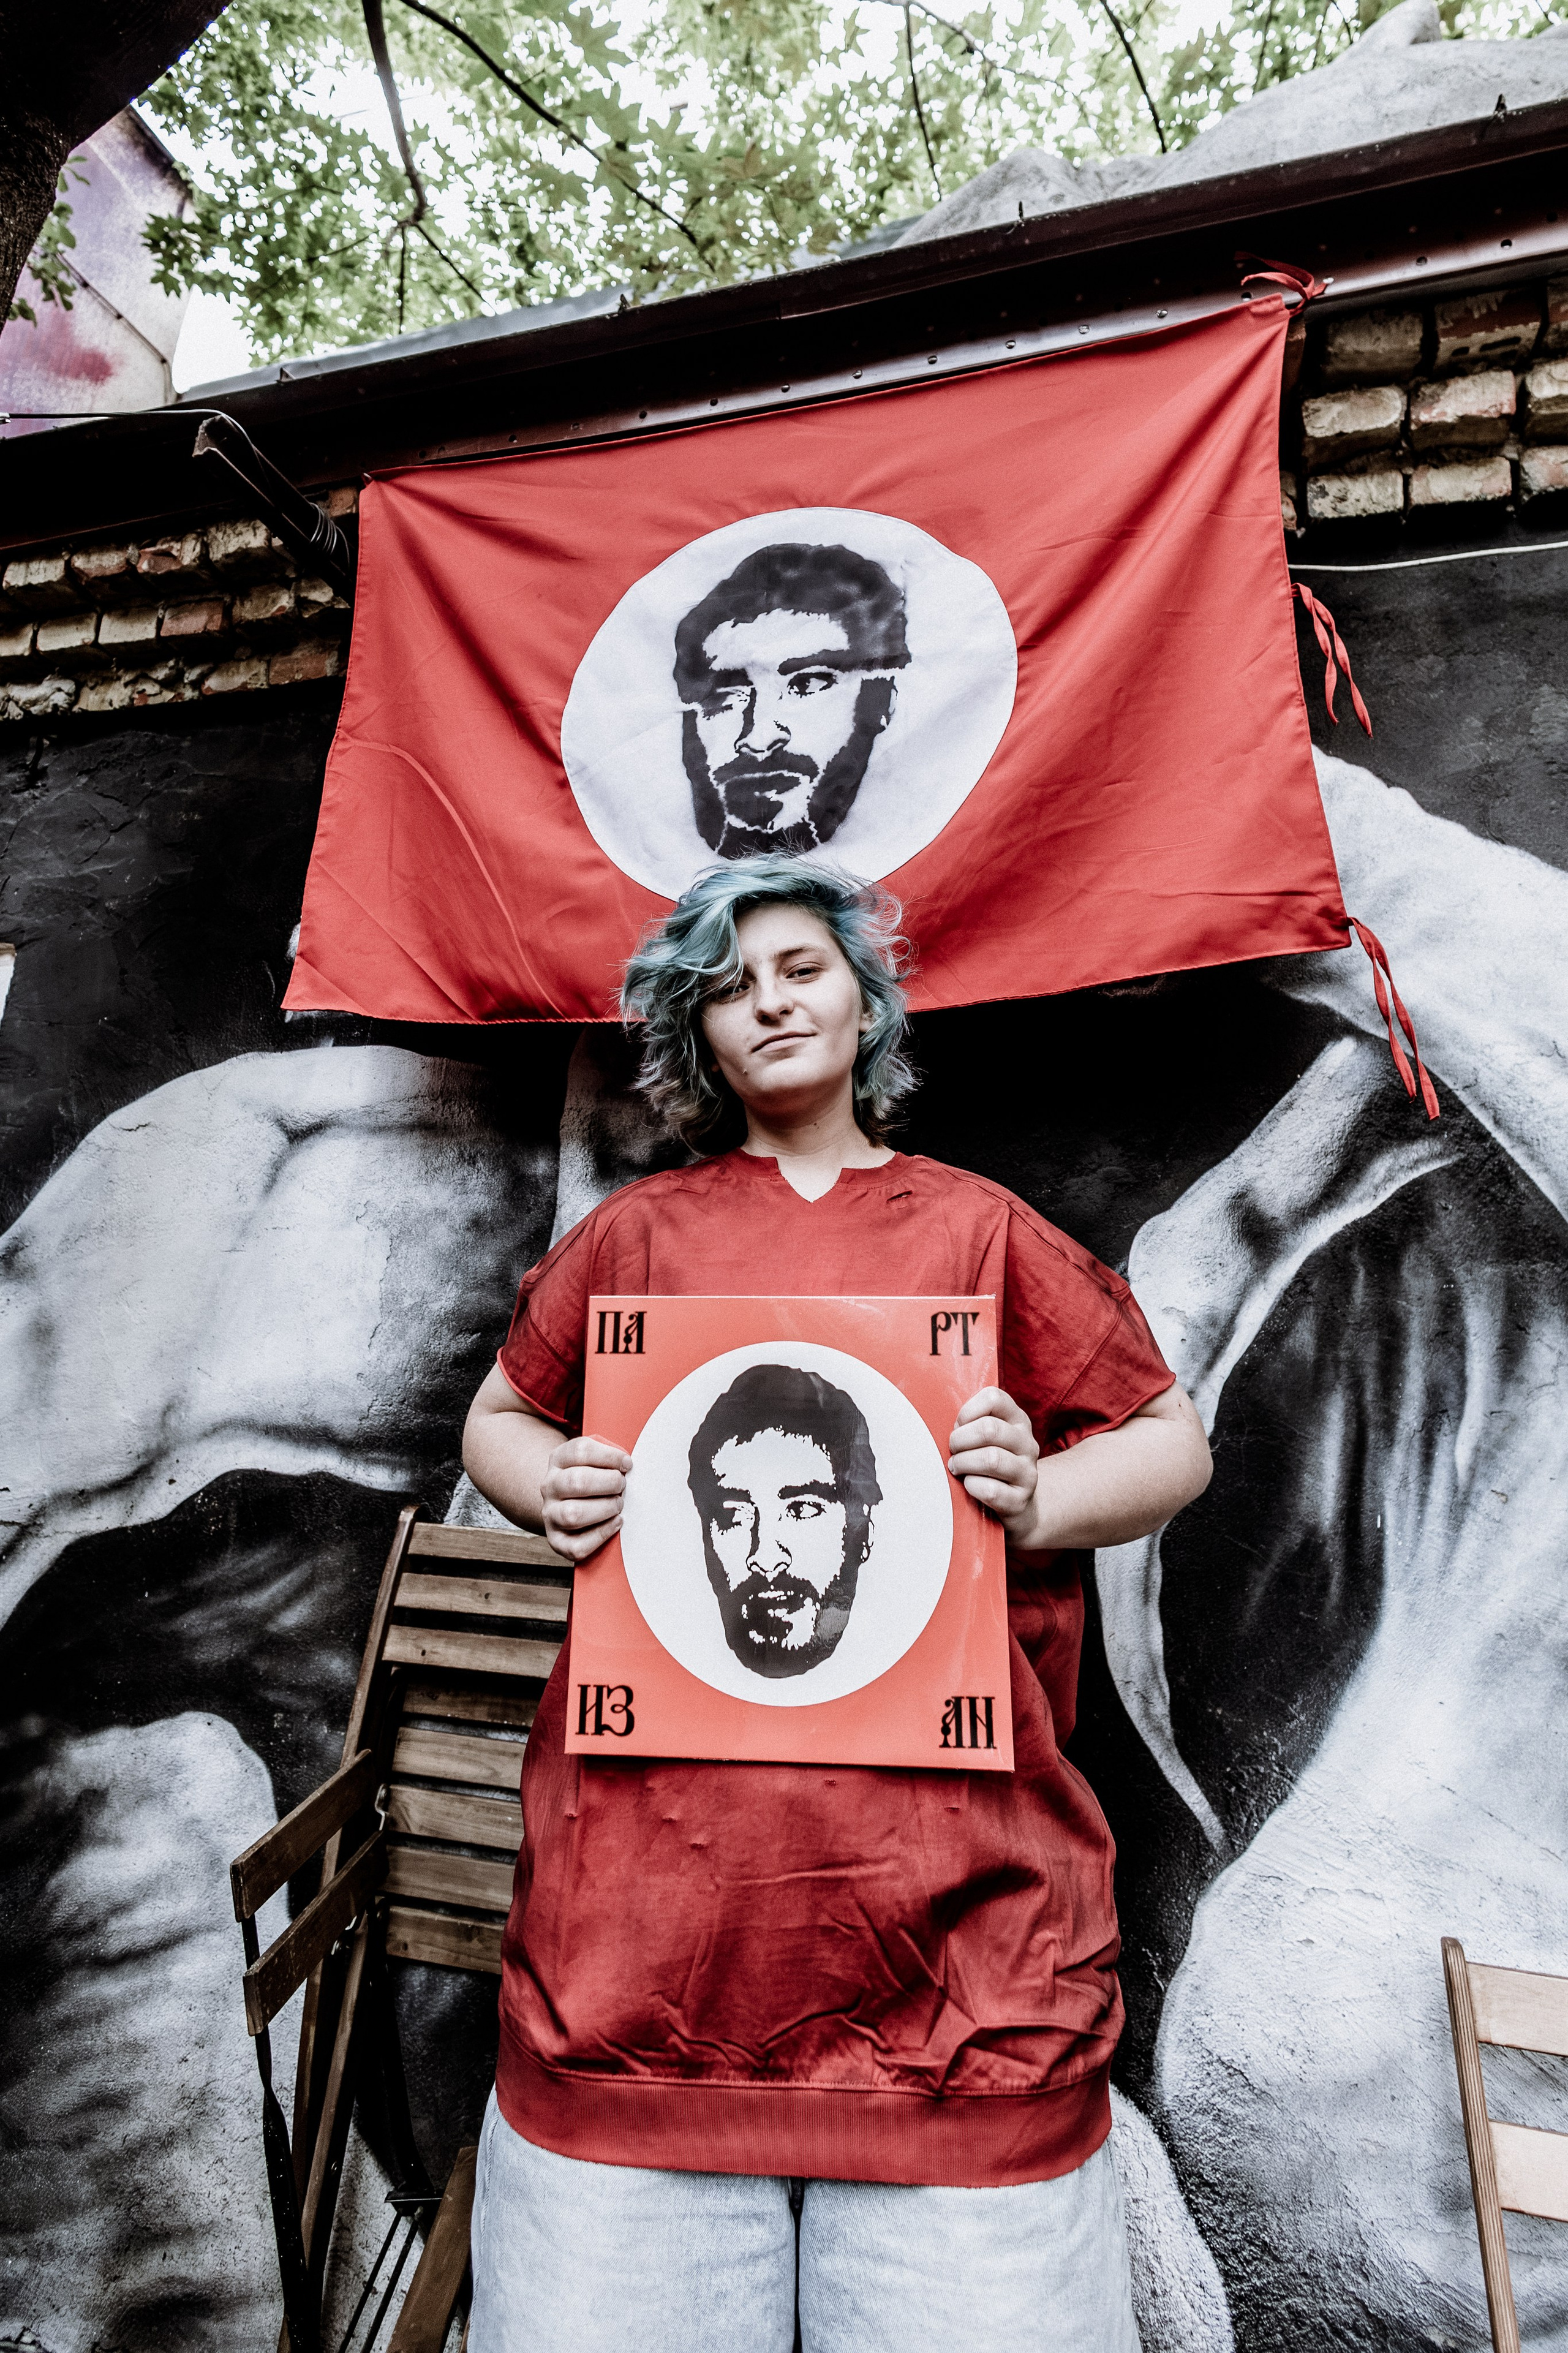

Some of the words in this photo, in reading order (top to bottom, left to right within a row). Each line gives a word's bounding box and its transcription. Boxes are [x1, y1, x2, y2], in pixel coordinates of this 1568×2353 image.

[595, 1311, 647, 1354] ПА
[930, 1312, 980, 1356] РТ
[575, 1684, 635, 1737] ИЗ
[939, 1696, 997, 1749] АН
